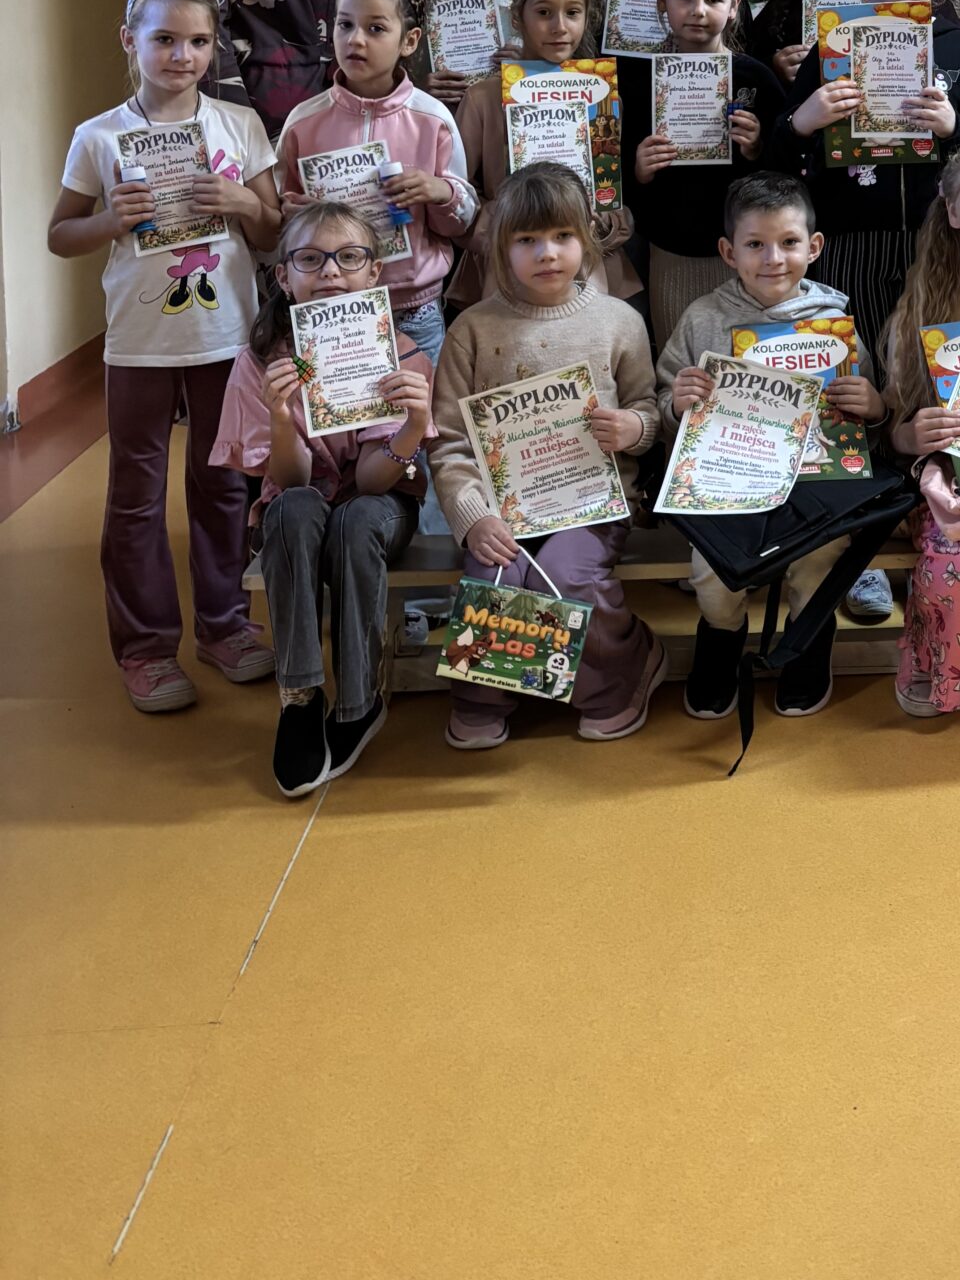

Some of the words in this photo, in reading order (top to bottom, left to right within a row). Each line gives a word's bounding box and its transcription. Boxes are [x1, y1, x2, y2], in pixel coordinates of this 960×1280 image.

[865, 31, 919, 48] DYPLOM
[667, 61, 719, 77] DYPLOM
[520, 78, 600, 88] KOLOROWANKA
[523, 108, 578, 127] DYPLOM
[133, 132, 195, 156] DYPLOM
[318, 153, 376, 179] DYPLOM
[310, 301, 377, 329] DYPLOM
[342, 340, 364, 350] udział
[752, 339, 838, 354] KOLOROWANKA
[718, 372, 802, 409] DYPLOM
[492, 382, 581, 425] DYPLOM
[747, 405, 760, 413] Dla
[534, 417, 546, 426] Dla
[742, 424, 767, 437] zajęcie
[505, 423, 552, 447] Michaliny
[539, 431, 564, 444] zajęcie
[720, 428, 728, 438] I
[729, 429, 777, 451] miejsca
[520, 449, 531, 459] II
[534, 435, 581, 458] miejsca
[527, 454, 555, 469] szkolnym
[555, 446, 584, 459] konkursie
[708, 443, 779, 466] plastyczno-technicznym
[719, 440, 748, 454] szkolnym
[748, 446, 776, 457] konkursie
[519, 450, 591, 478] plastyczno-technicznym
[463, 605, 571, 651] Memory
[489, 631, 536, 659] Las
[553, 657, 564, 666] +3
[485, 676, 496, 685] dla
[497, 679, 516, 689] dzieci
